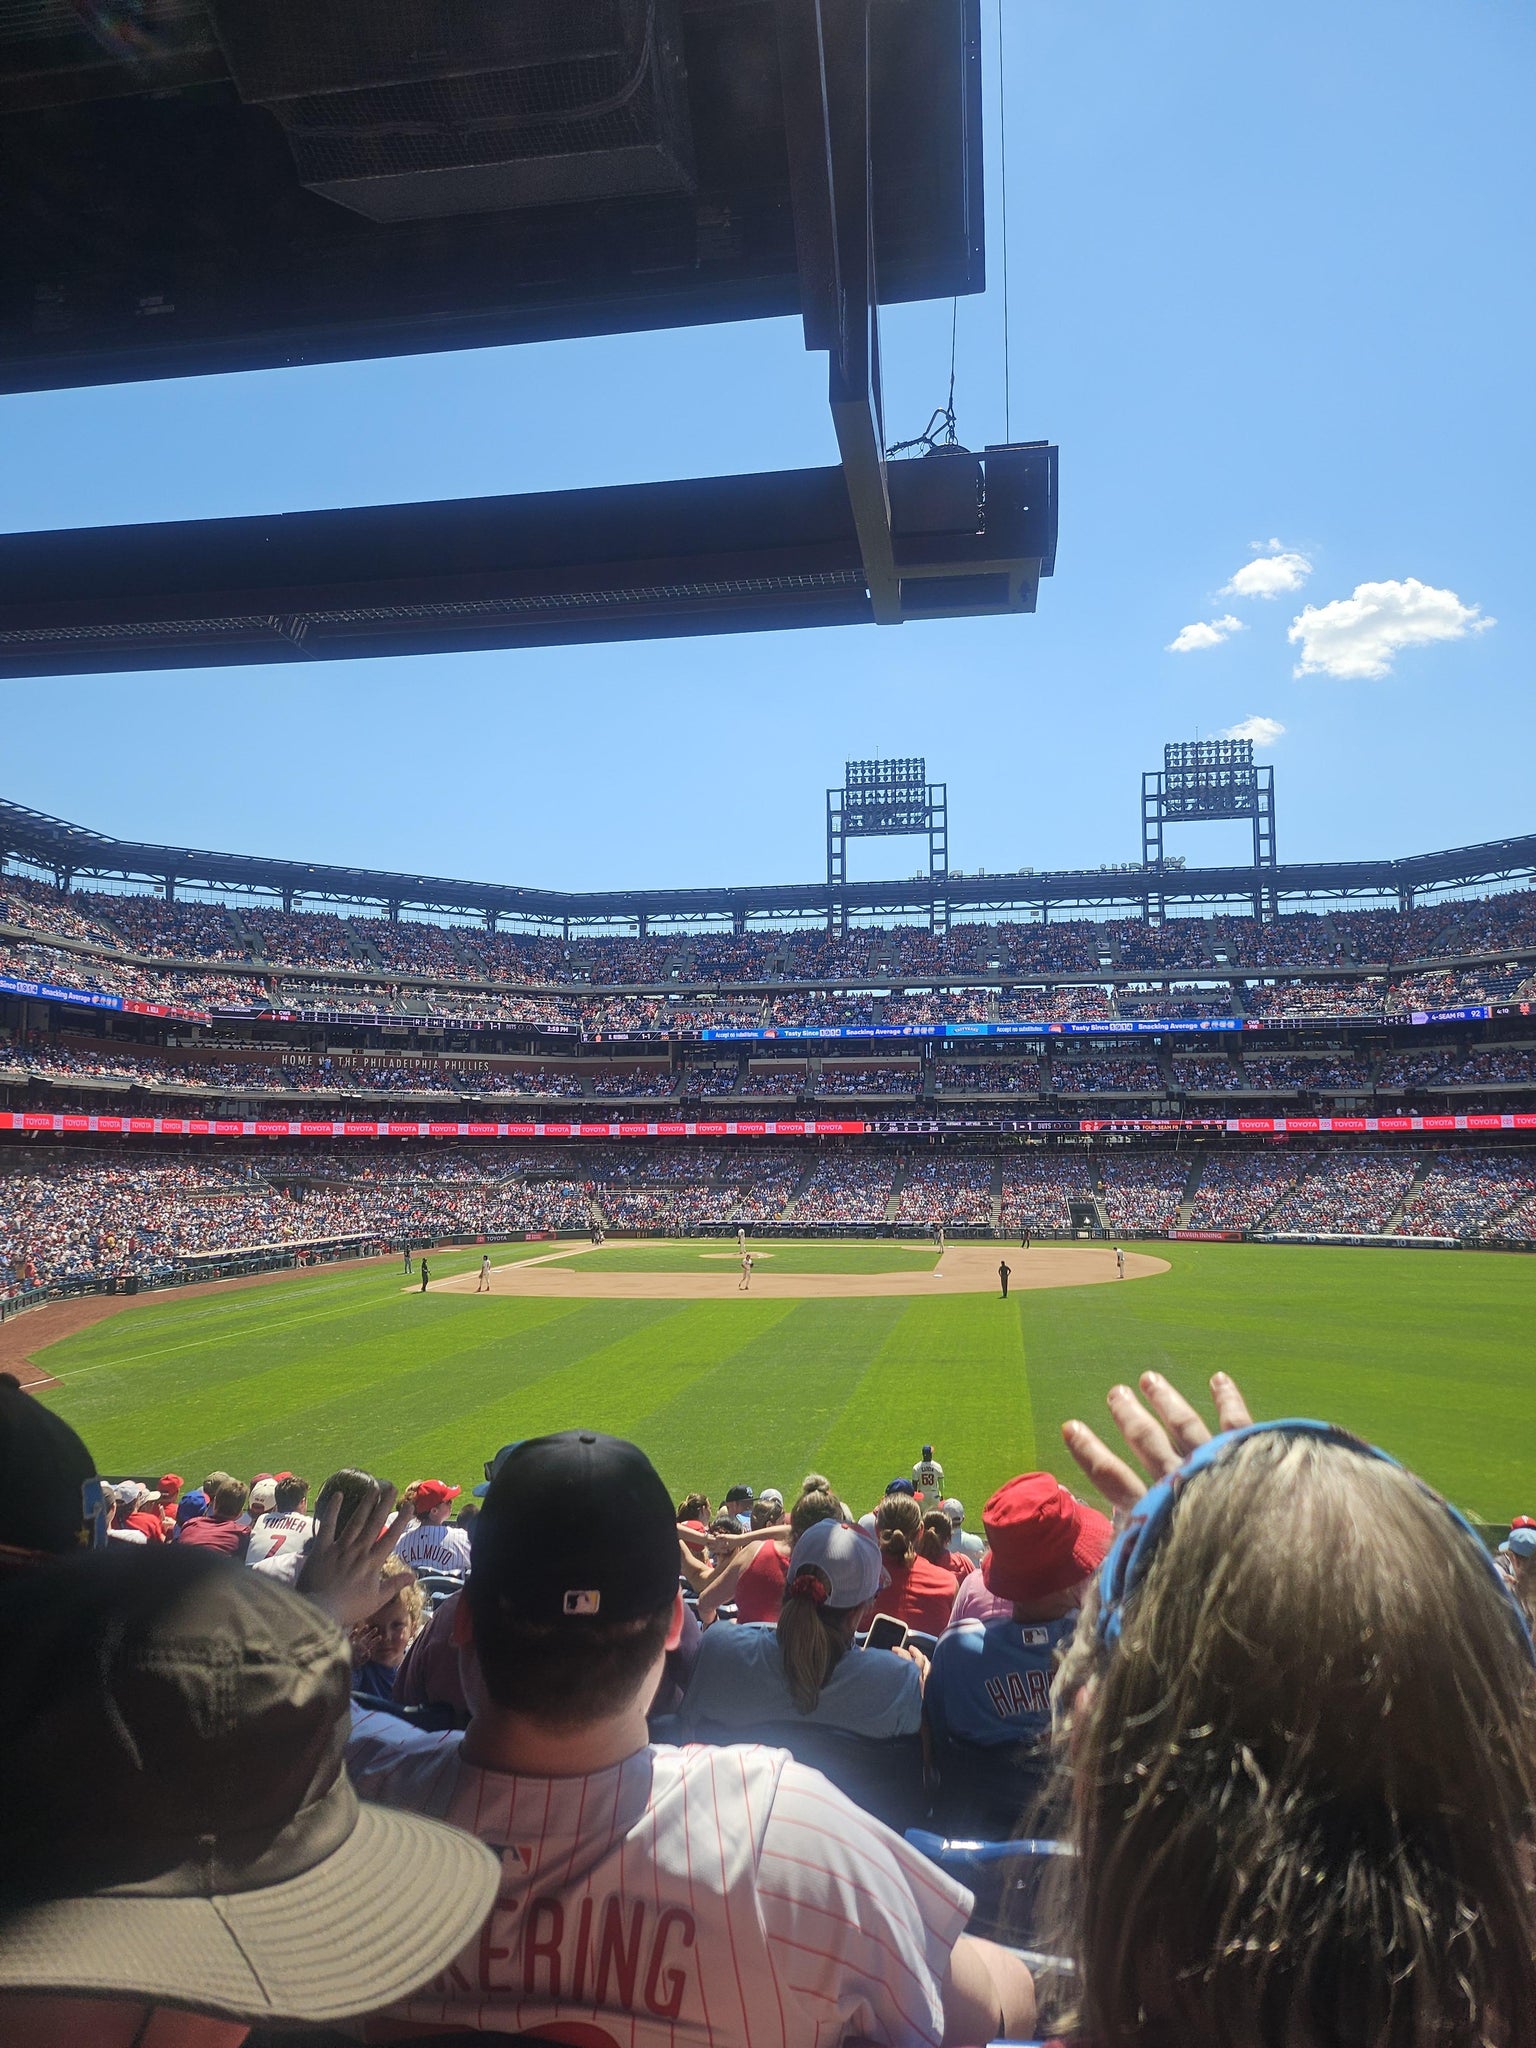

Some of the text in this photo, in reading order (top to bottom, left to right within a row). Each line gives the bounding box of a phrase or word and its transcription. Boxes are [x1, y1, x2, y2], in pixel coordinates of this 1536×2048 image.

[42, 988, 90, 1003] Snacking Average
[1431, 1012, 1456, 1020] 4-SEAM
[1138, 1023, 1169, 1031] Snacking
[281, 1055, 312, 1066] HOME
[338, 1057, 357, 1066] THE
[364, 1057, 438, 1070] PHILADELPHIA
[445, 1060, 489, 1070] PHILLIES
[26, 1118, 50, 1126] TOYOTA
[65, 1118, 87, 1126] TOYOTA
[100, 1120, 120, 1128] TOYOTA
[163, 1122, 181, 1130] TOYOTA
[263, 1516, 307, 1533] TURNER
[264, 1534, 287, 1559] 7
[401, 1543, 453, 1566] EALMUTO
[434, 1896, 696, 2020] ERING
